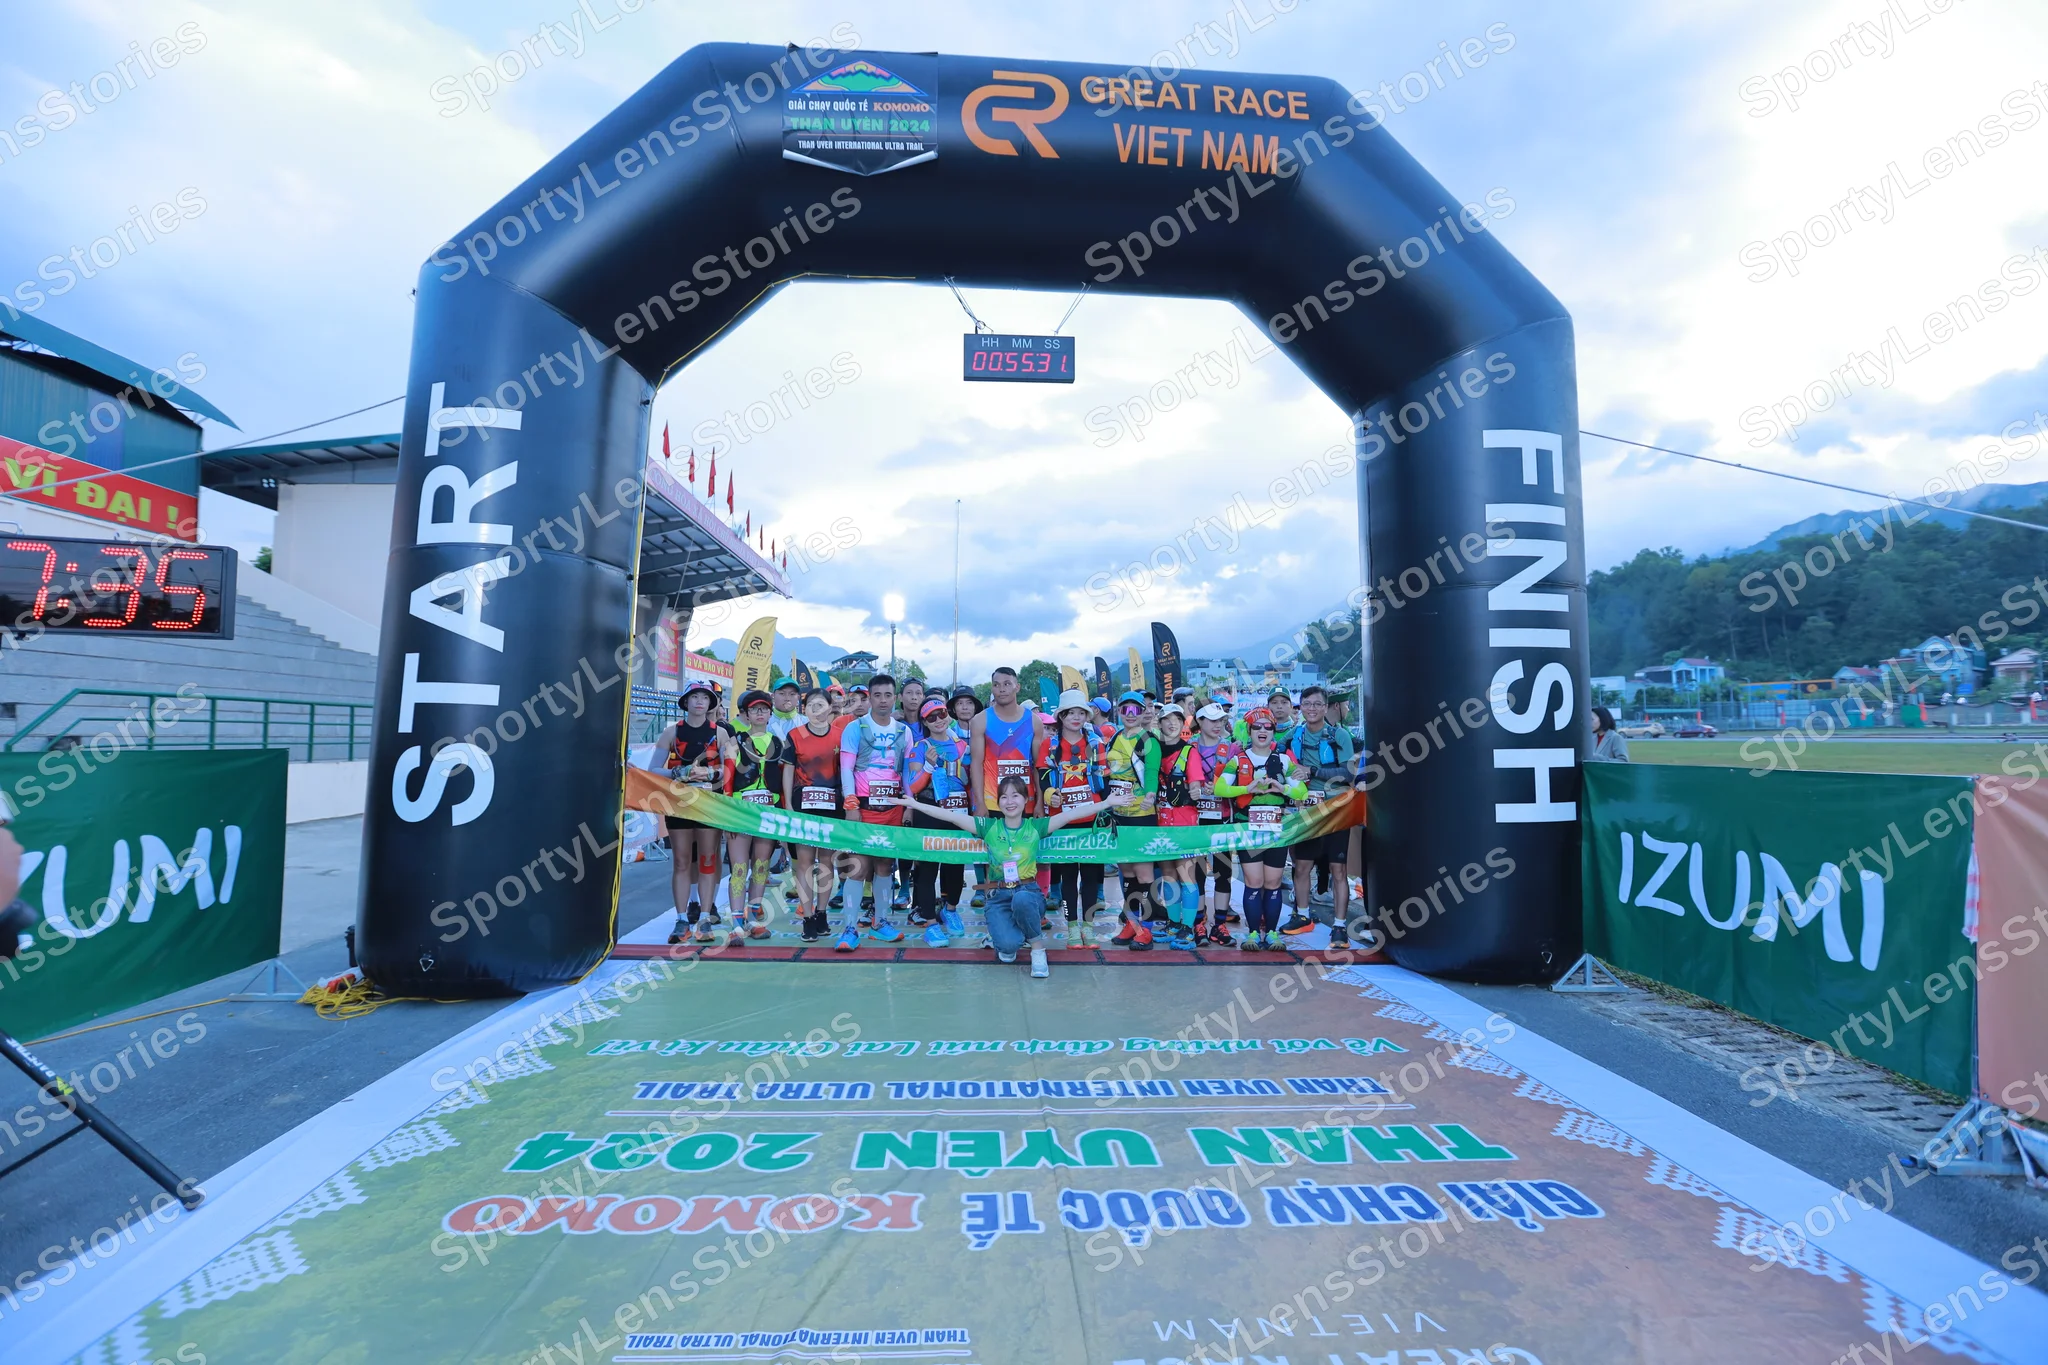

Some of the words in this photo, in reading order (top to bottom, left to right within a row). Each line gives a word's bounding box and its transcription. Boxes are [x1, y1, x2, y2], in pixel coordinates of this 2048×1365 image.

[1080, 76, 1201, 111] GREAT
[1213, 85, 1310, 121] RACE
[873, 102, 930, 113] KOMOMO
[790, 117, 836, 131] THAN
[840, 116, 884, 131] UYÊN
[888, 119, 931, 133] 2024
[798, 140, 816, 149] THAN
[816, 140, 833, 150] UYEN
[834, 141, 884, 151] INTERNATIONAL
[885, 141, 905, 151] ULTRA
[906, 142, 924, 151] TRAIL
[1113, 122, 1192, 168] VIET
[1201, 130, 1280, 175] NAM
[981, 337, 999, 347] HH
[1012, 338, 1032, 349] MM
[1044, 339, 1061, 349] SS
[73, 480, 151, 523] ĐẠI
[391, 382, 522, 827] START
[1482, 429, 1577, 823] FINISH
[1004, 766, 1025, 775] 2506
[808, 792, 829, 800] 2558
[876, 787, 894, 795] 2574
[1067, 793, 1087, 802] 2589
[748, 796, 769, 804] 2560
[946, 798, 963, 807] 2575
[1196, 800, 1216, 808] 2503
[1256, 813, 1277, 821] 2567
[759, 812, 834, 843] START
[922, 836, 988, 853] KOMOM
[1619, 831, 1885, 971] IZUMI
[717, 1040, 840, 1057] Châu
[841, 1040, 921, 1057] Lai
[634, 1081, 750, 1102] TRAIL
[752, 1081, 874, 1101] ULTRA
[887, 1079, 1179, 1101] INTERNATIONAL
[1179, 1079, 1284, 1097] UYEN
[1284, 1077, 1397, 1096] THAN
[503, 1131, 822, 1172] 2024
[851, 1127, 1163, 1178] UYÊN
[1188, 1124, 1518, 1167] THAN
[1265, 1178, 1444, 1227] CHẠY
[1437, 1180, 1605, 1233] GIẢI
[442, 1194, 924, 1237] KOMOMO
[624, 1333, 675, 1349] TRAIL
[676, 1332, 737, 1349] ULTRA
[737, 1329, 871, 1348] INTERNATIONAL
[873, 1330, 921, 1346] UYEN
[923, 1329, 971, 1344] THAN
